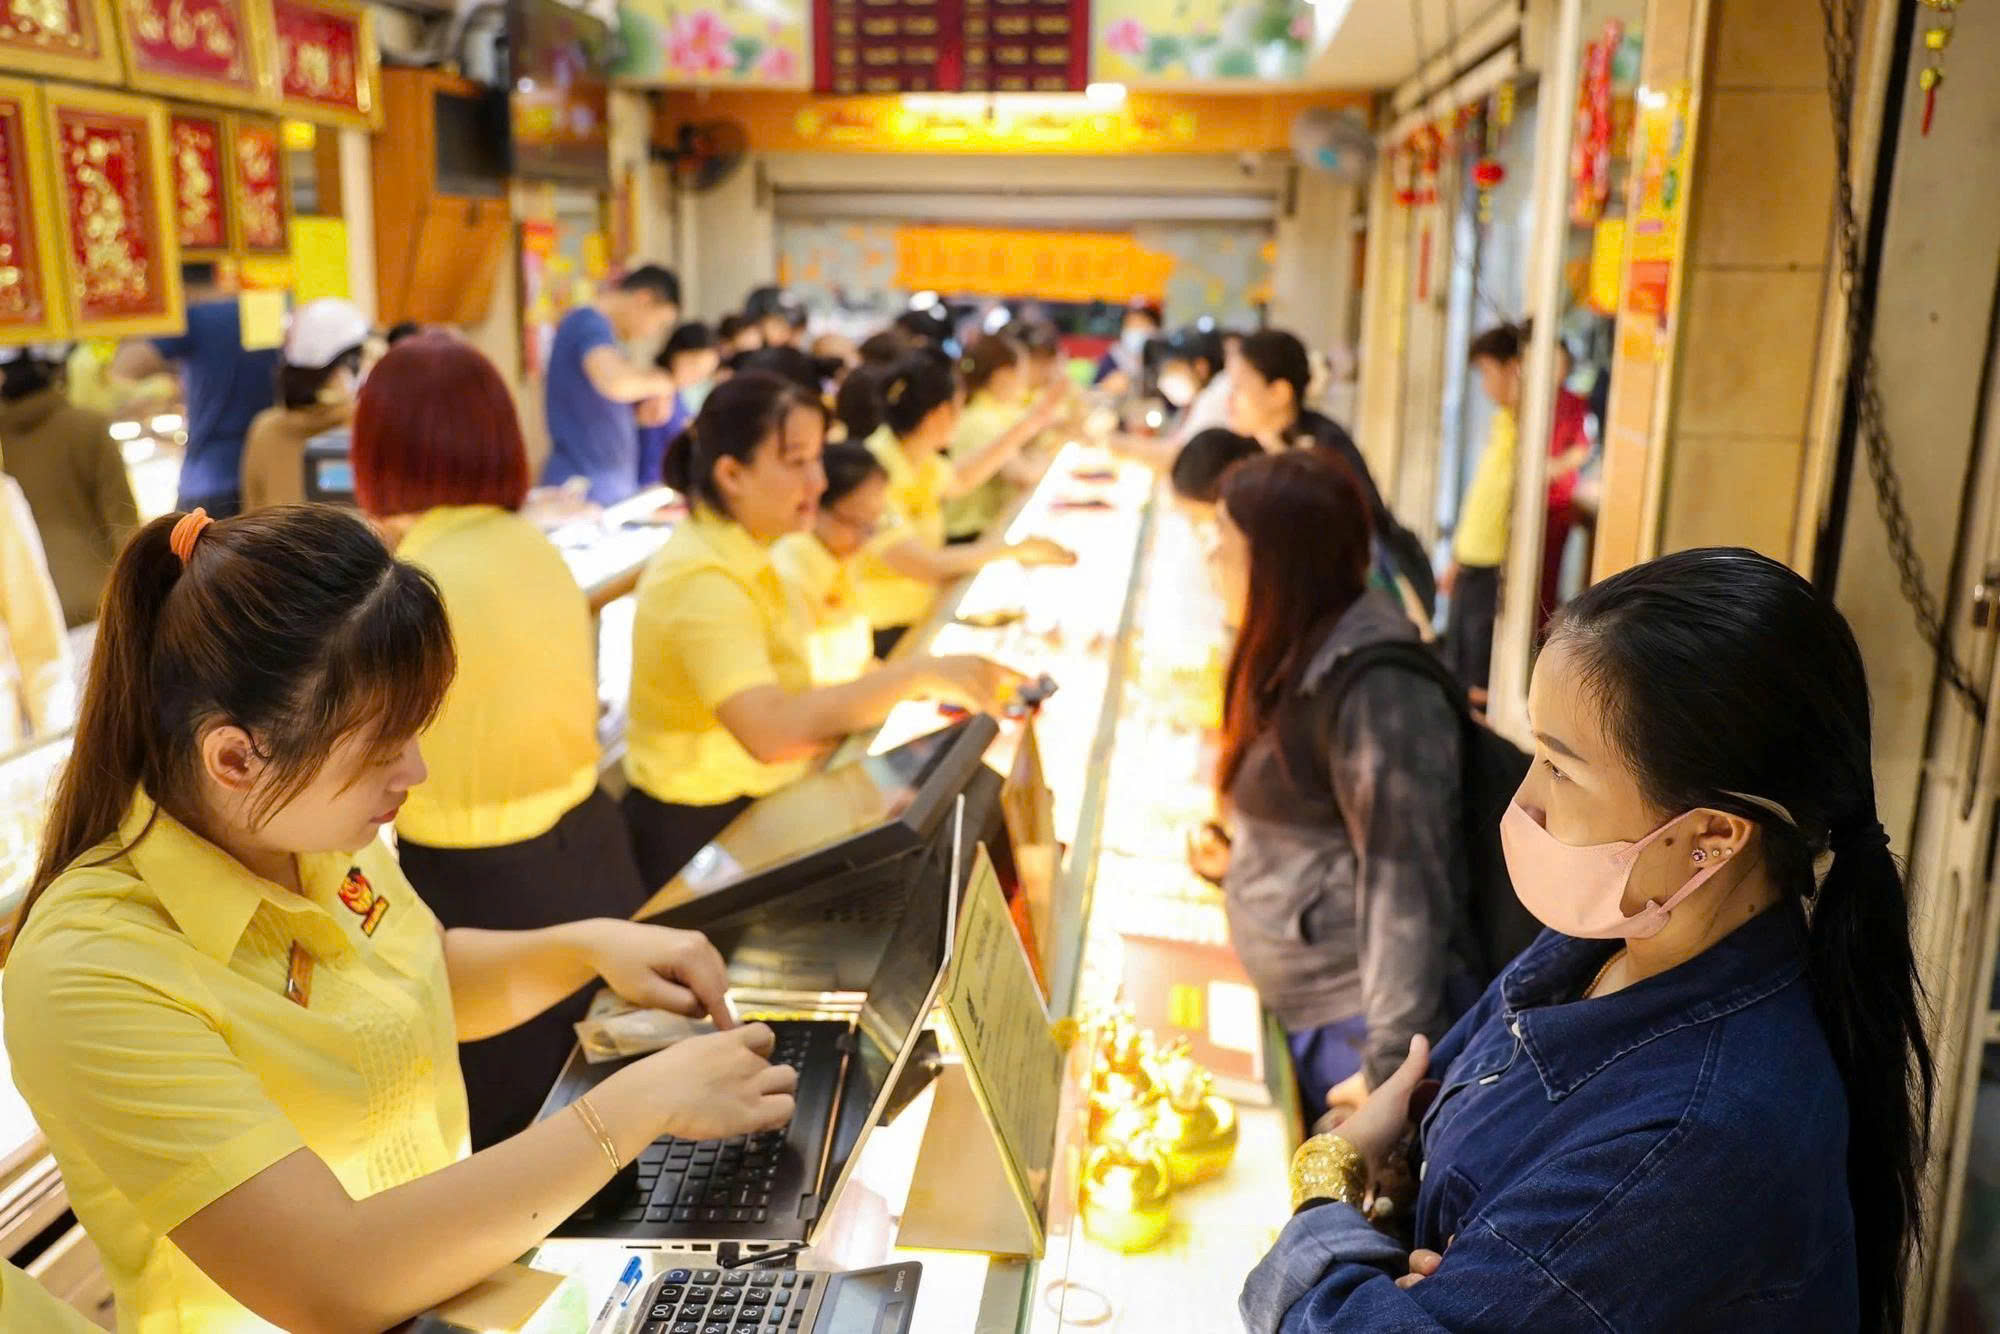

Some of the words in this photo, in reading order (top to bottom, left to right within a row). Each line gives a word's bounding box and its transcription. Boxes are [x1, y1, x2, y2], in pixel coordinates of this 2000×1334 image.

[670, 1270, 684, 1278] C
[894, 1270, 906, 1292] CASIO
[720, 1290, 735, 1298] 4
[750, 1292, 766, 1300] 7
[652, 1304, 669, 1317] 00
[682, 1307, 698, 1315] 2
[712, 1308, 728, 1316] 5
[743, 1309, 758, 1317] 8
